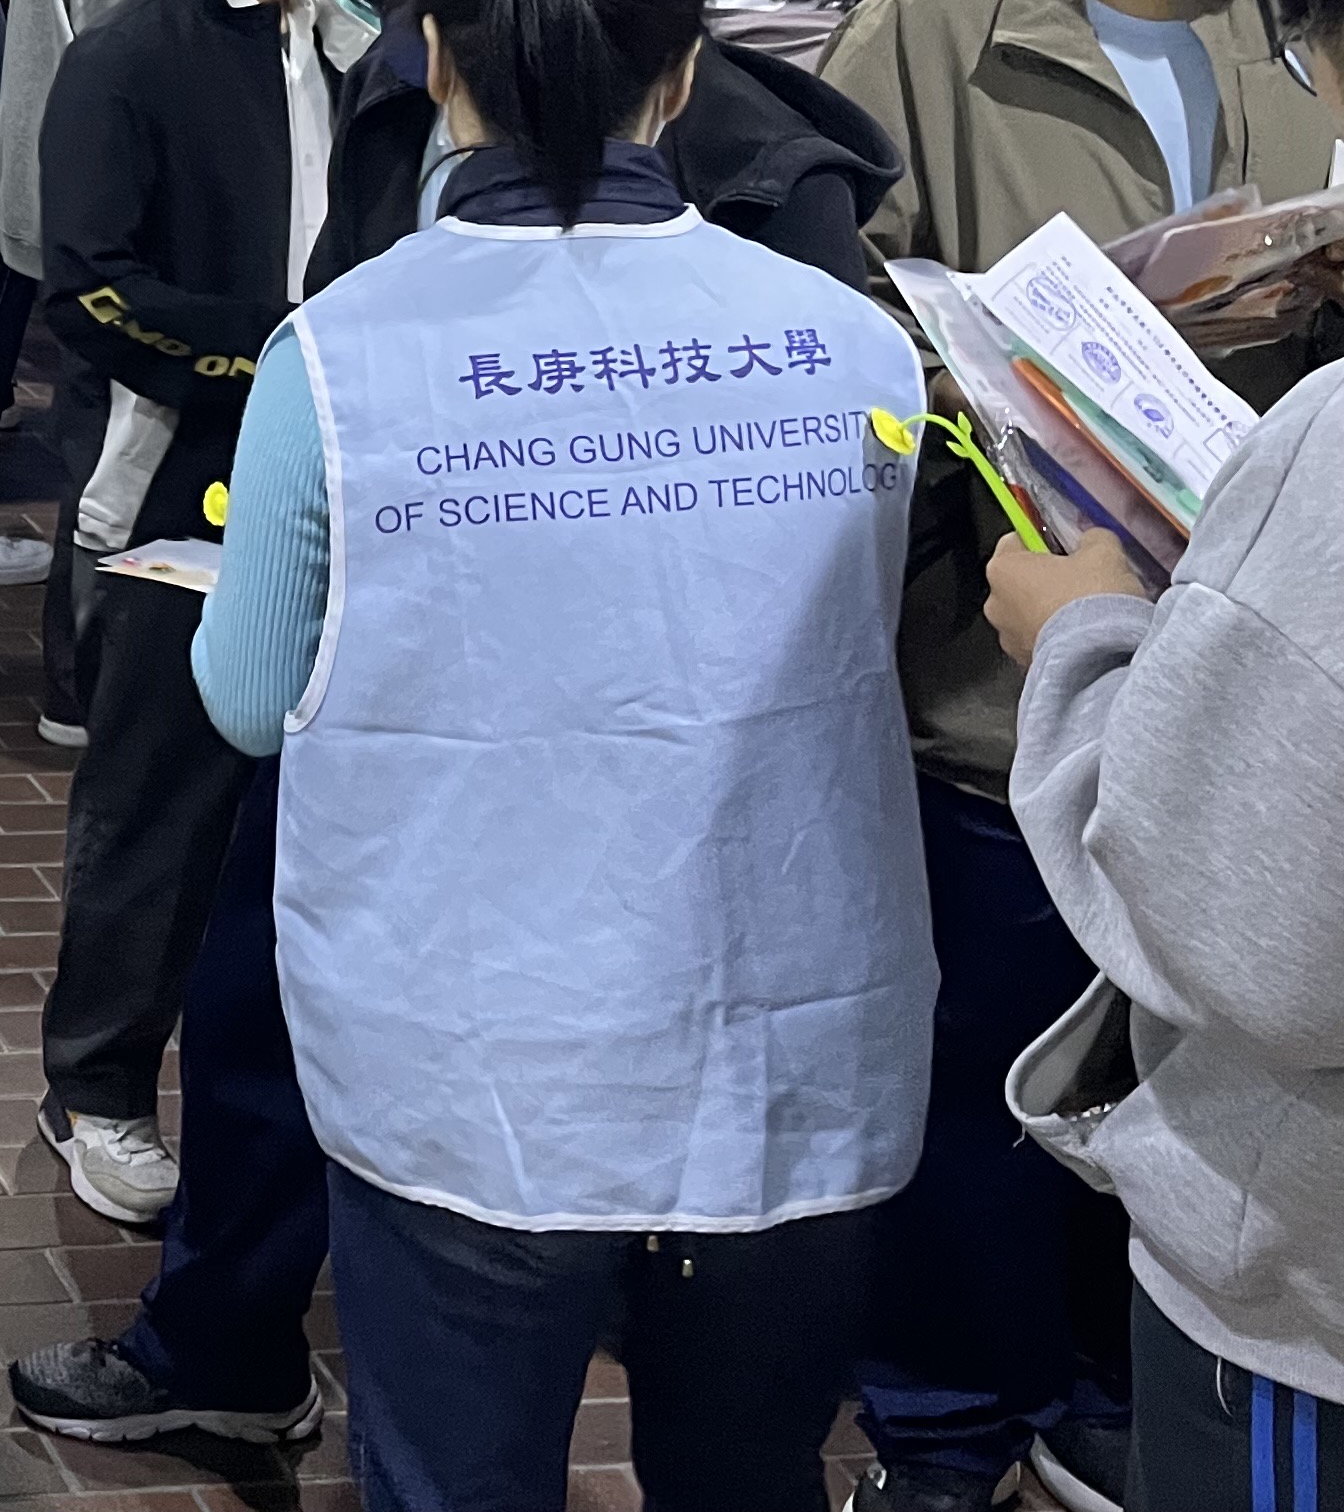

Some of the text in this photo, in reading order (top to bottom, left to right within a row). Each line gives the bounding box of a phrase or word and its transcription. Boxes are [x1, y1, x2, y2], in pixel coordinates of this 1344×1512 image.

[458, 327, 832, 400] 長庚科技大學
[416, 409, 873, 477] CHANG GUNG UNIVERSIT
[374, 463, 902, 534] OF SCIENCE AND TECHNOLOG
